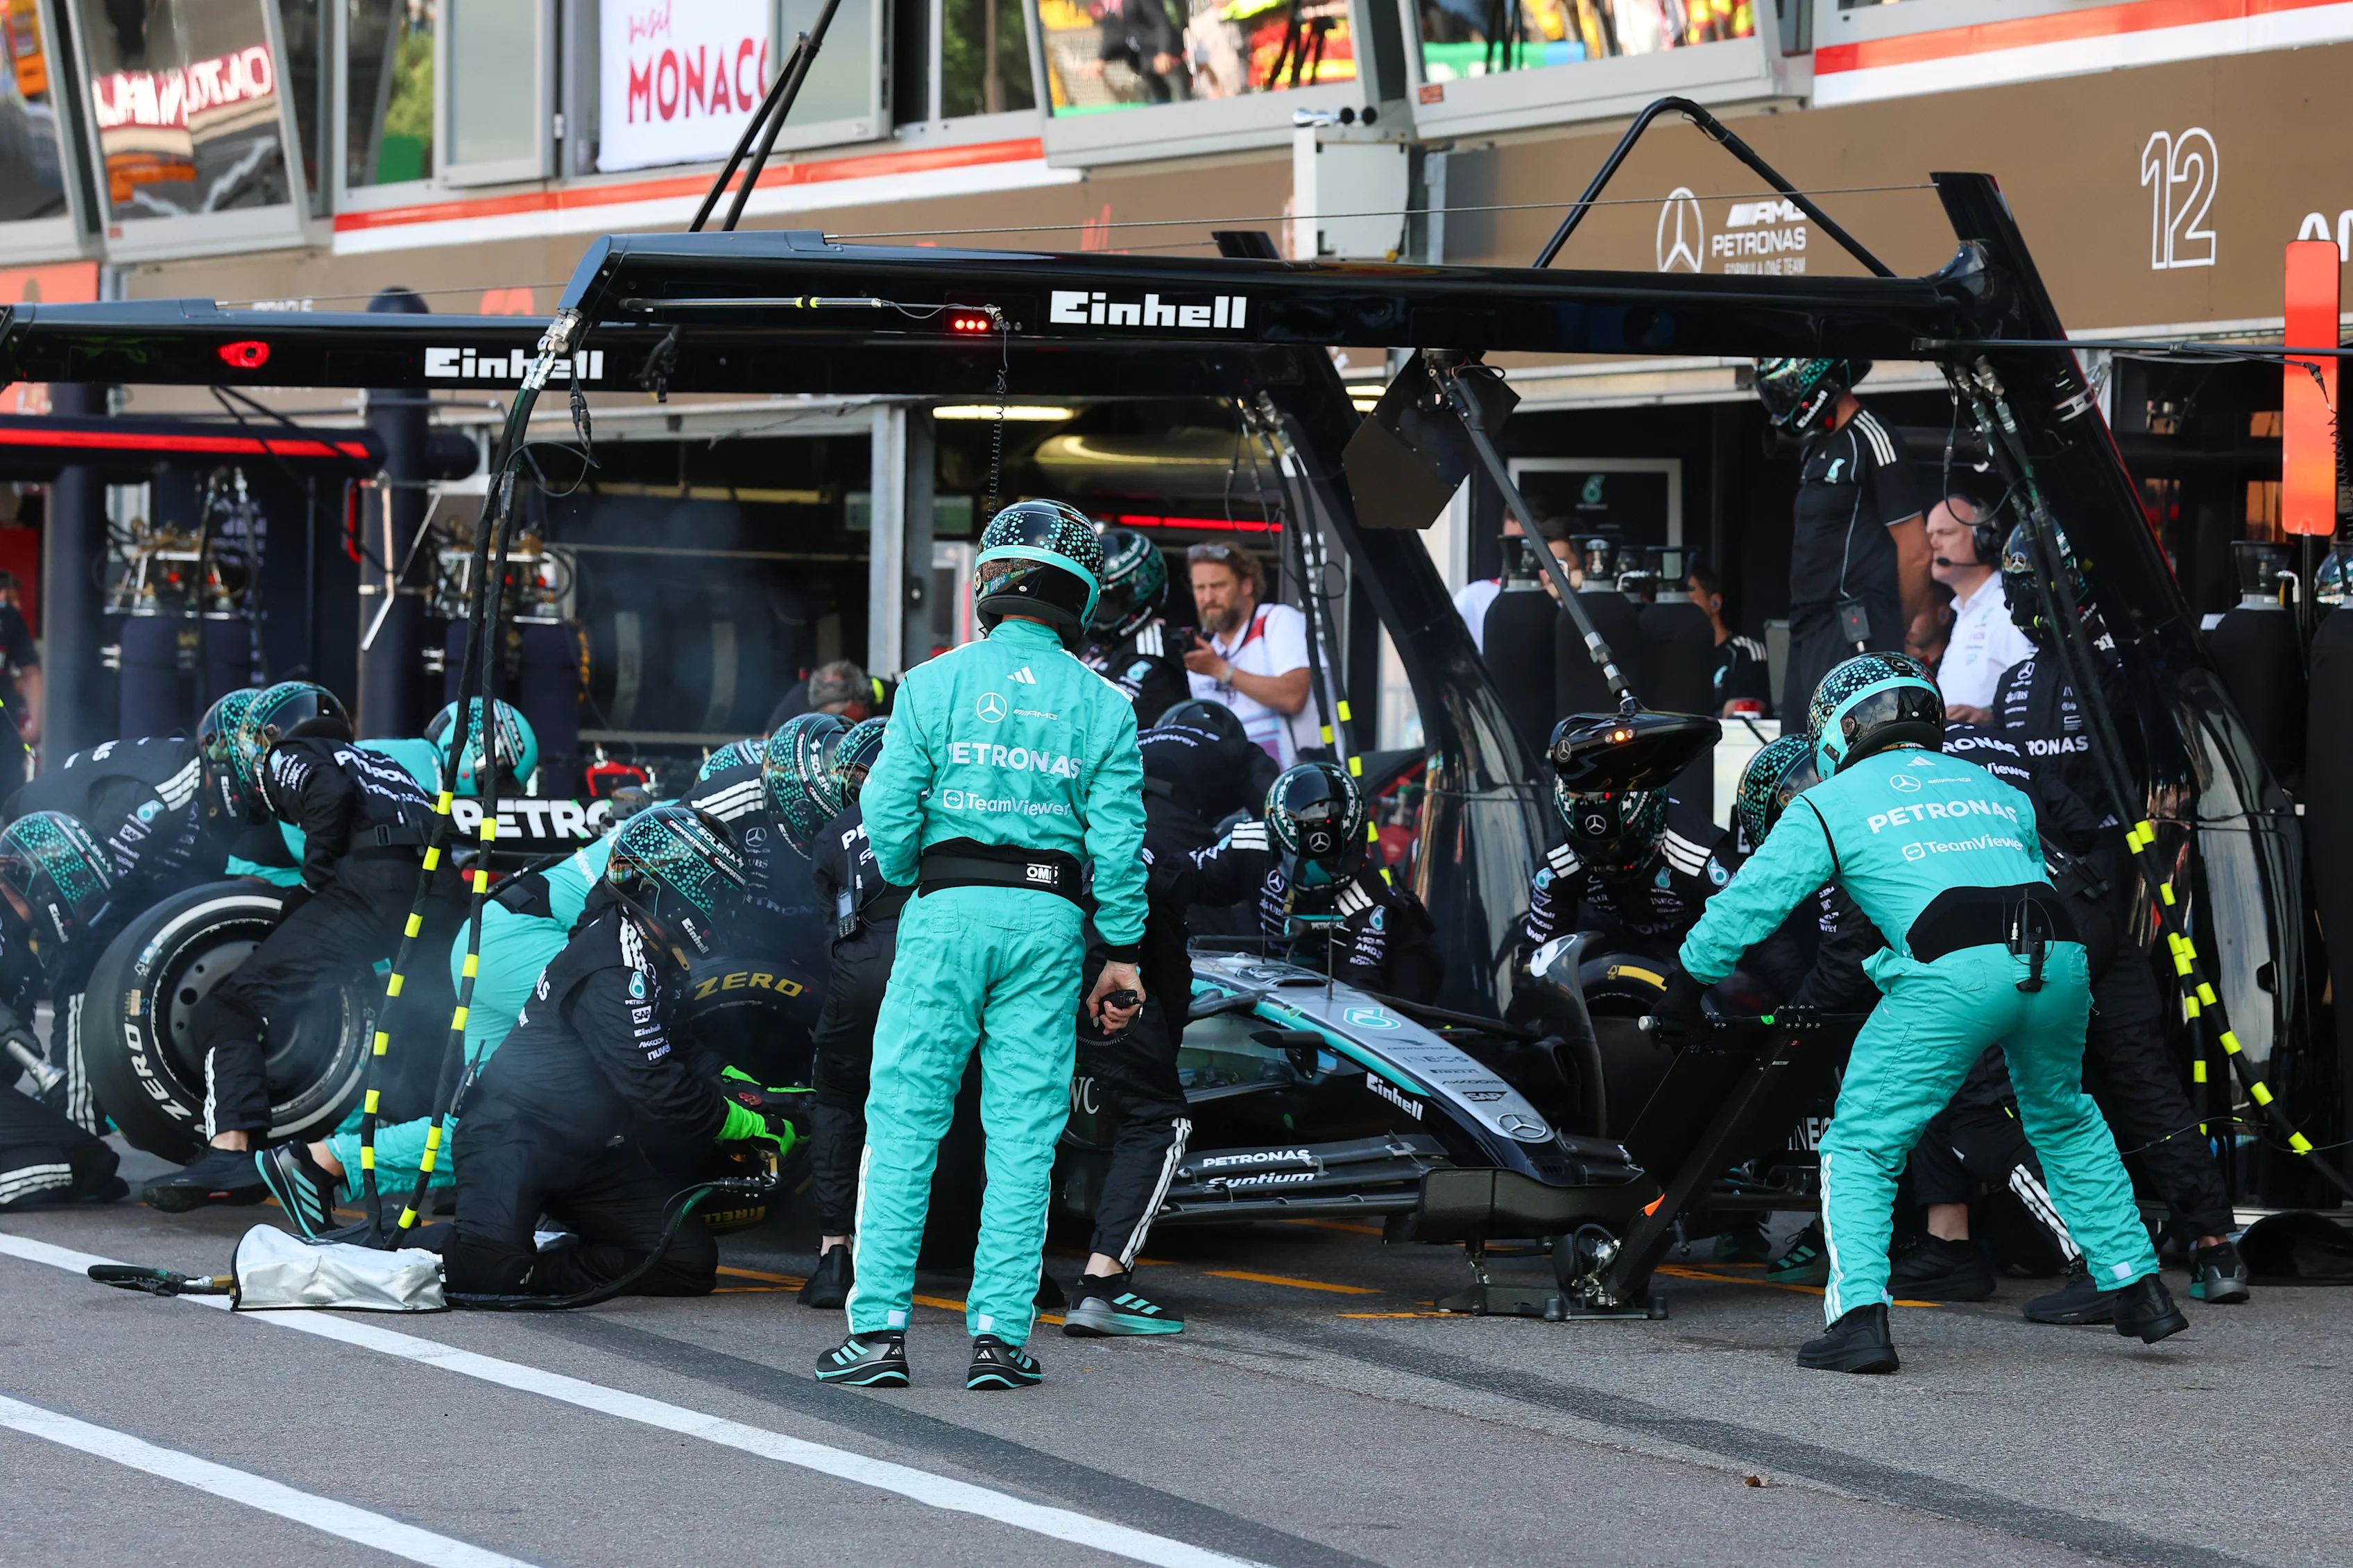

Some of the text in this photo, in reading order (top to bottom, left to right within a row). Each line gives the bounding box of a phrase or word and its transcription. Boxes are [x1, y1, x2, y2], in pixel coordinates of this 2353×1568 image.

[1754, 198, 1807, 225] AMG
[2141, 127, 2218, 270] 12
[1711, 226, 1807, 258] PETRONAS
[1765, 259, 1782, 275] ONE
[1050, 291, 1247, 329] Einhell
[425, 347, 604, 380] Einhell
[1027, 709, 1059, 721] AMG
[797, 732, 810, 782] CROWDSTRIKE
[1942, 736, 2021, 757] RONAS
[2026, 735, 2089, 756] RONAS
[1980, 762, 2030, 780] Viewer
[810, 786, 838, 818] CROWDSTR
[966, 792, 1071, 816] TeamViewer
[1867, 799, 2018, 834] PETRONAS
[451, 799, 614, 838] PETRO
[669, 819, 711, 856] CROWDSTRIKE
[696, 827, 737, 863] SOLERA
[1923, 834, 2023, 854] TeamViewer
[714, 857, 747, 886] CROWDSTRIKE
[1027, 865, 1059, 881] OMP
[681, 917, 710, 954] Einhell
[1310, 921, 1345, 931] PETROAS
[694, 972, 804, 1001] ZERO
[124, 1022, 193, 1121] ZERO
[1070, 1076, 1101, 1114] WC
[1367, 1071, 1423, 1121] Einhell
[1464, 1092, 1503, 1101] SAP
[1203, 1149, 1311, 1168] PETRONAS
[1206, 1171, 1315, 1189] Syntium
